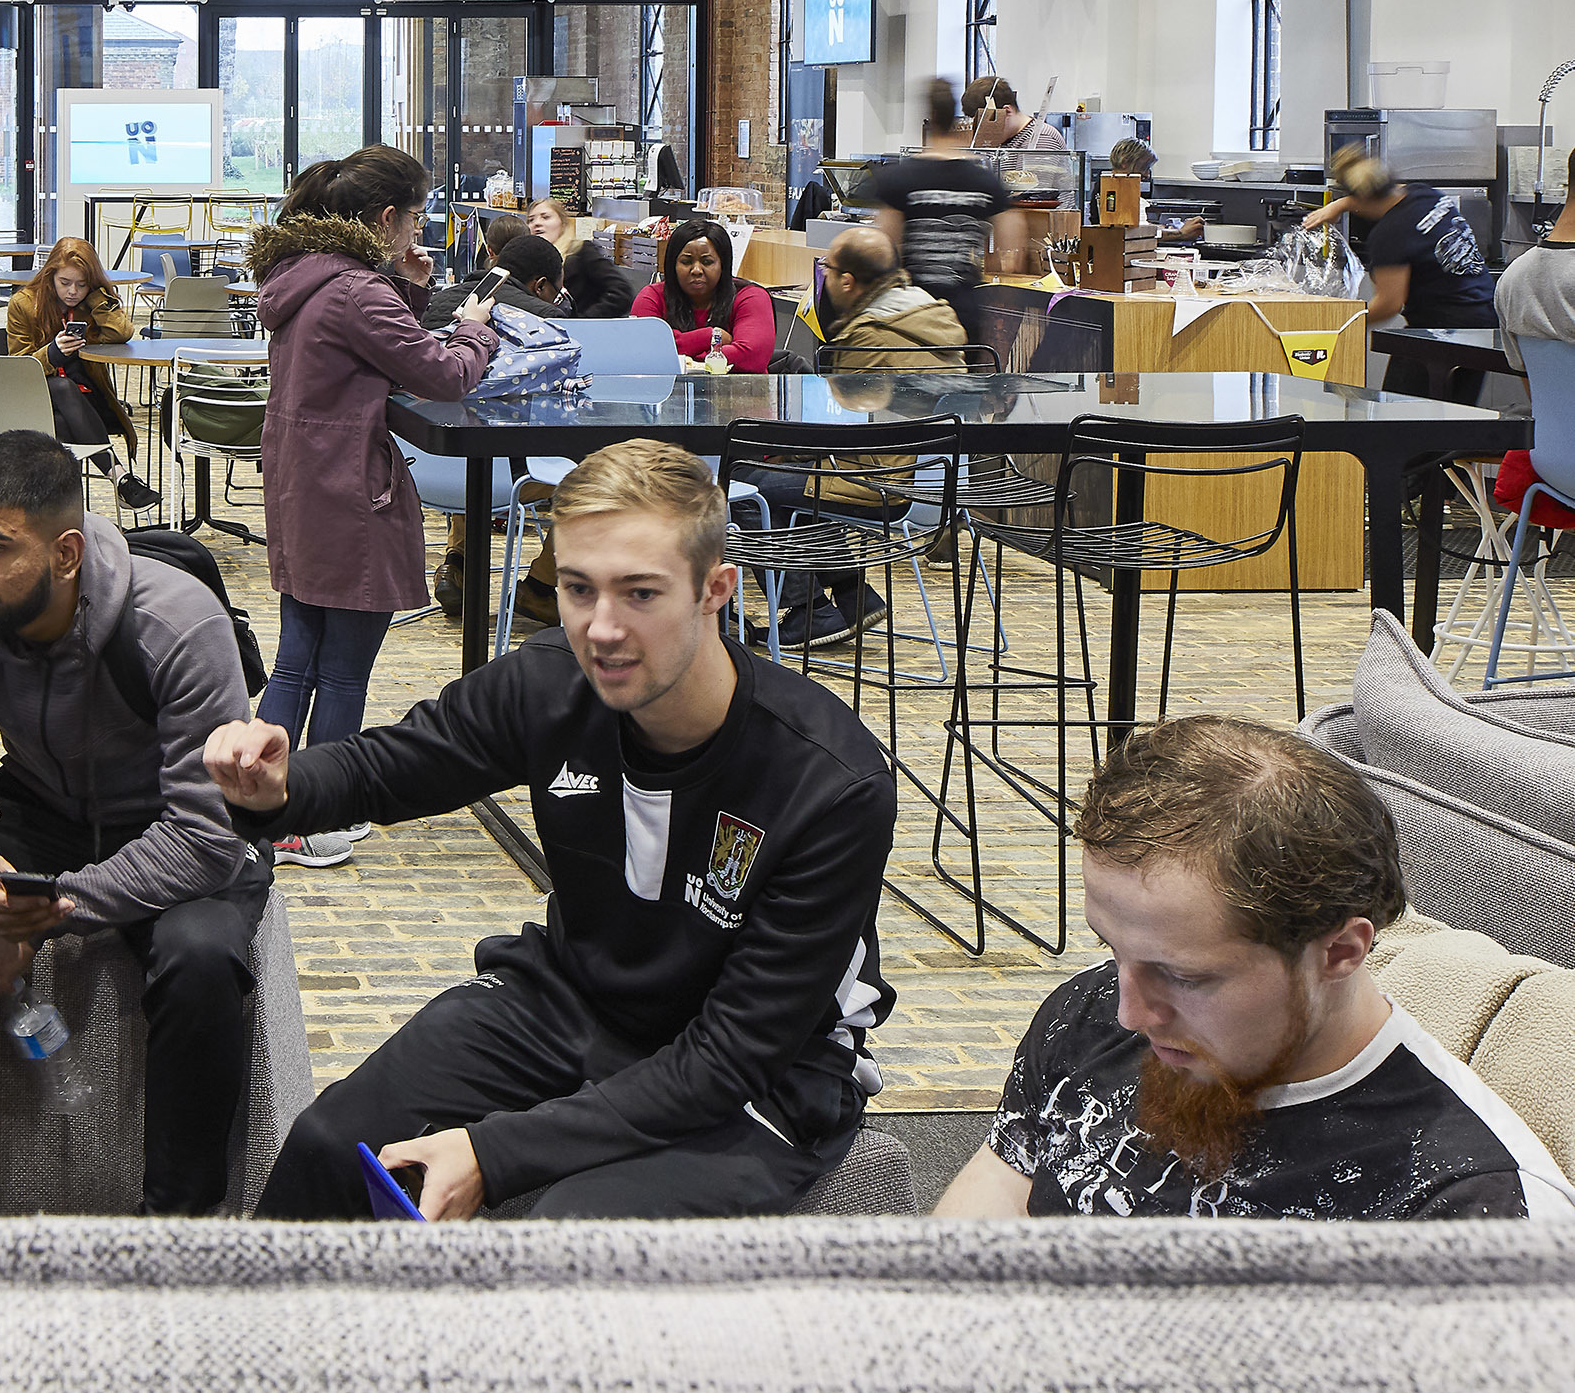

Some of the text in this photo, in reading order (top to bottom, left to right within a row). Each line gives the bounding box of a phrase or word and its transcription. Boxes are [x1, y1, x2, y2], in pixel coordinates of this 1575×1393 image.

[829, 8, 844, 47] N
[126, 120, 157, 136] UO
[127, 136, 158, 164] N
[547, 760, 600, 790] AVEC
[686, 872, 704, 889] UO
[684, 882, 702, 908] N
[730, 912, 743, 921] of
